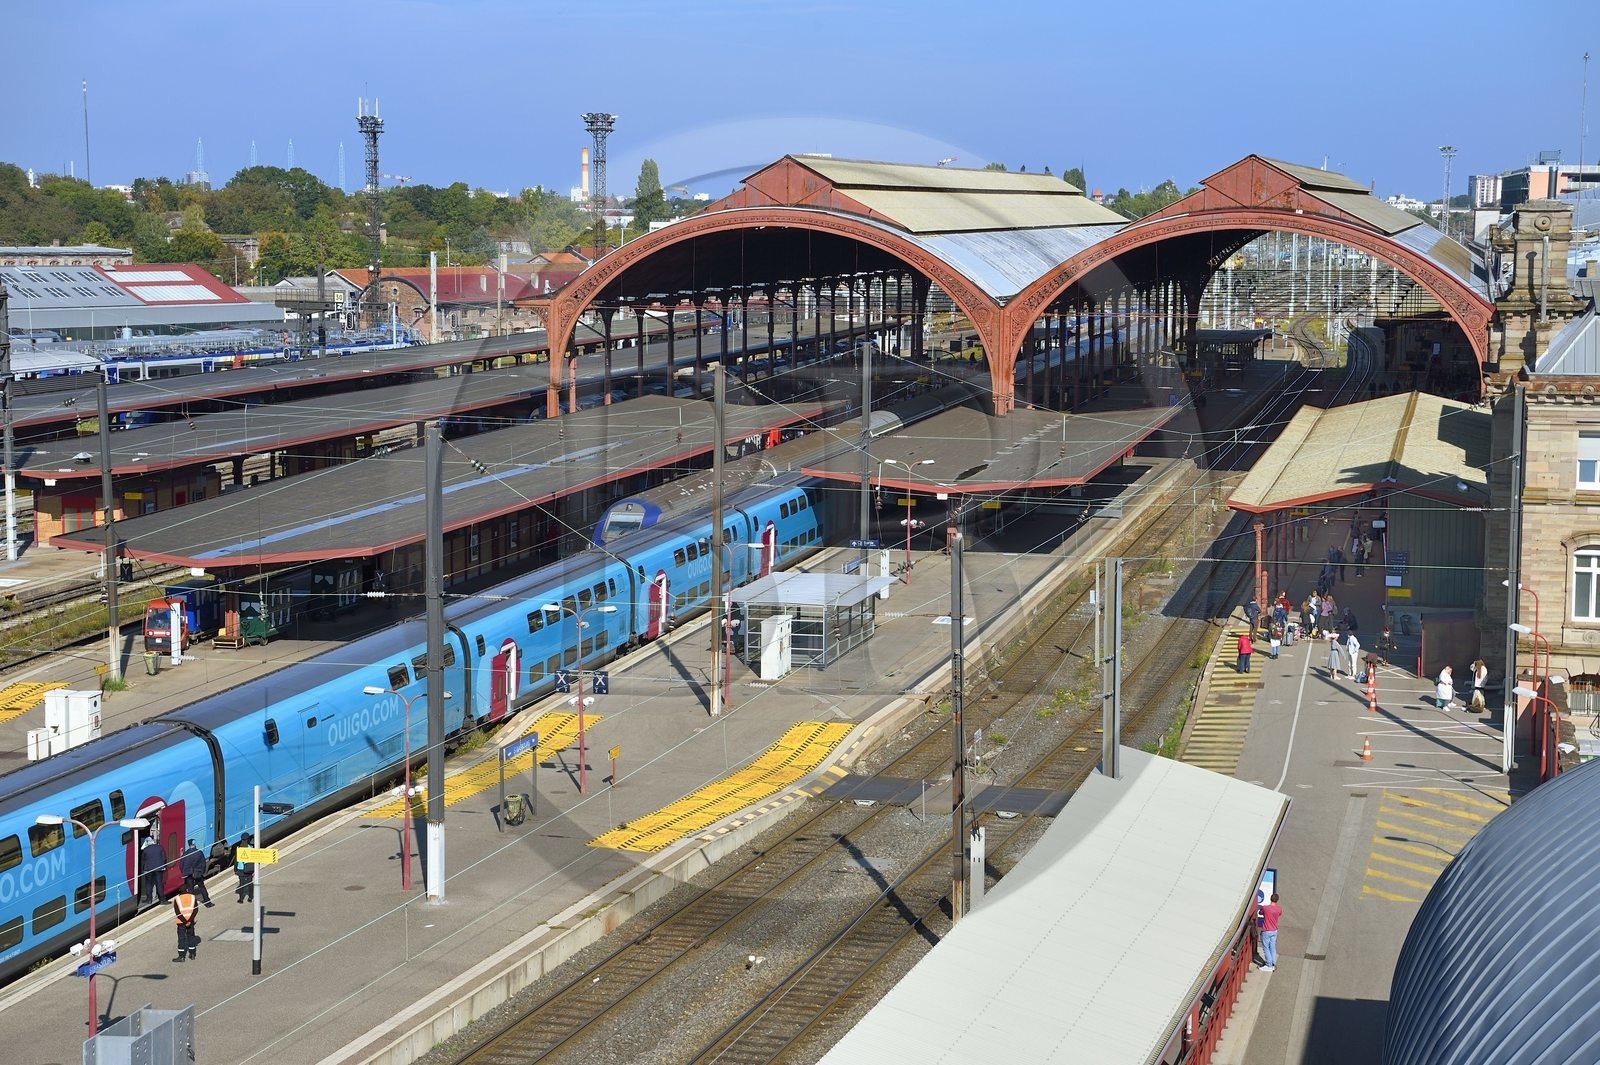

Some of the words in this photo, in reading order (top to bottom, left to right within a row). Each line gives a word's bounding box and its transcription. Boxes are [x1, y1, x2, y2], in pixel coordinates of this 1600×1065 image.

[687, 552, 713, 579] OUIGO.C
[557, 673, 567, 685] X
[595, 674, 606, 686] X
[328, 694, 399, 747] OUIGO.COM
[0, 847, 66, 904] O.COM
